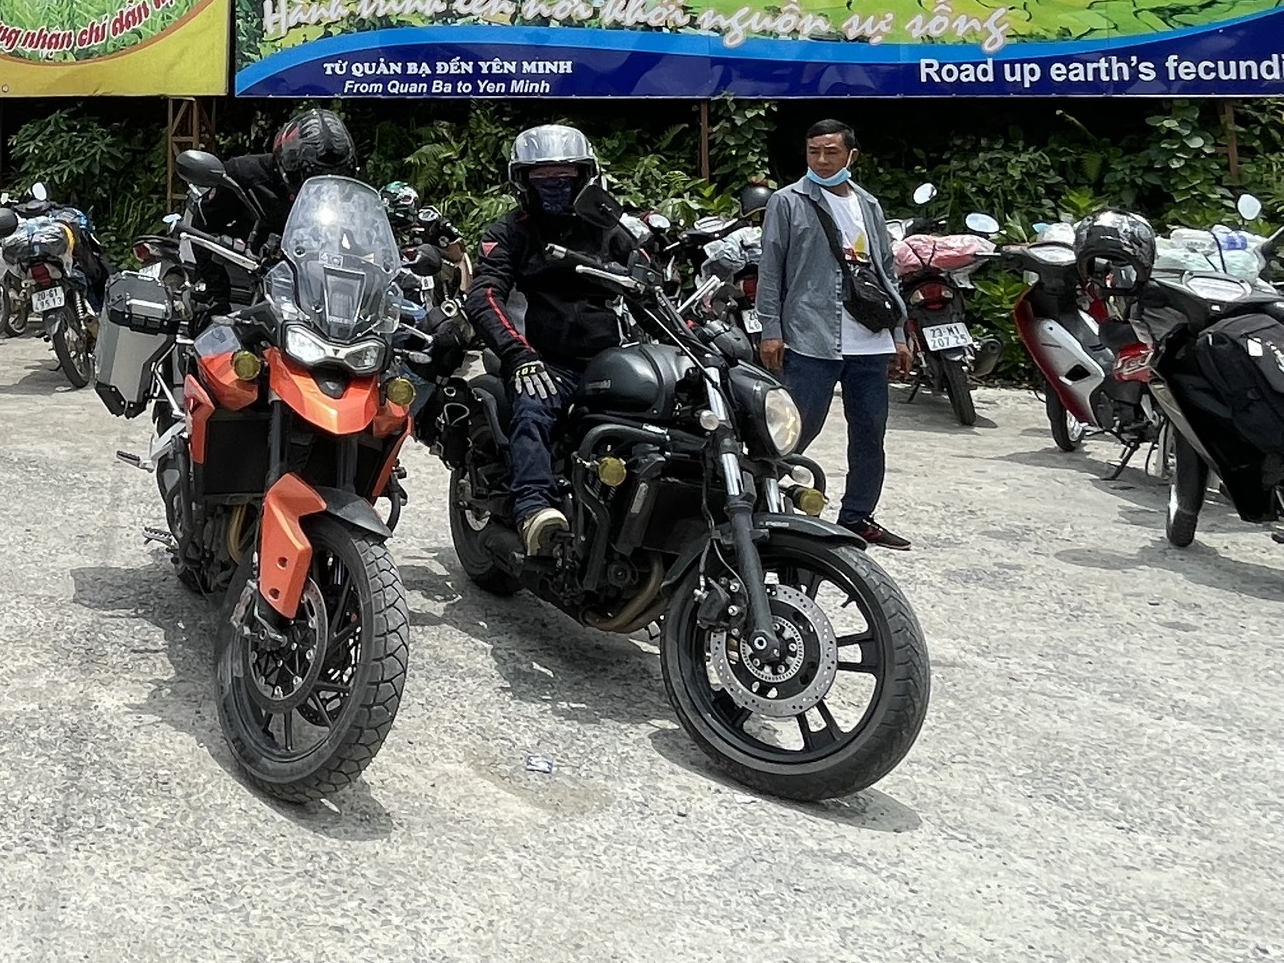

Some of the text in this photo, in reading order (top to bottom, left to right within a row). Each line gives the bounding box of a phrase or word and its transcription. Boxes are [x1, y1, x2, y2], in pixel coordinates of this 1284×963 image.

[19, 24, 74, 57] nhận
[842, 12, 894, 45] sự
[323, 55, 573, 78] TỪ QUẢN BẠ ĐẾN YÊN MINH
[919, 57, 994, 83] Road
[1004, 62, 1041, 88] up
[344, 80, 550, 95] From Quan Ba to Yen Minh
